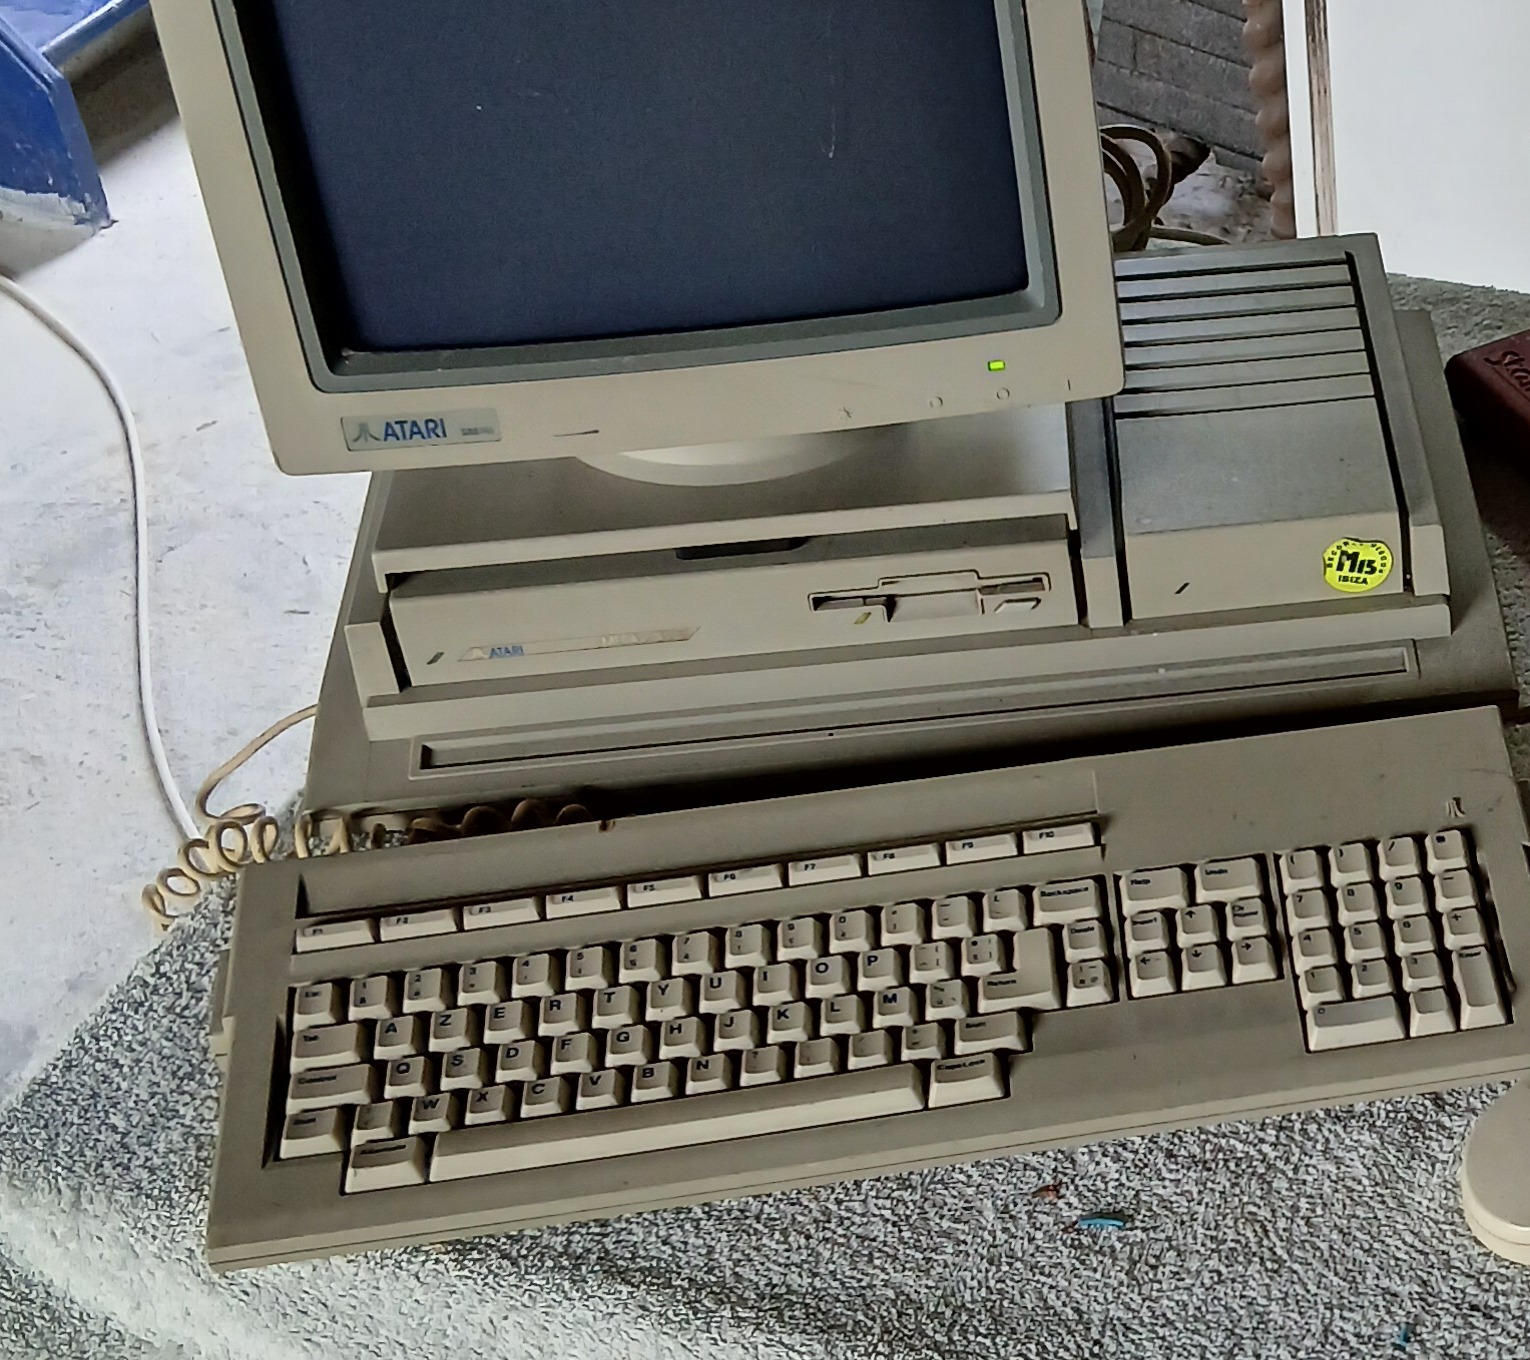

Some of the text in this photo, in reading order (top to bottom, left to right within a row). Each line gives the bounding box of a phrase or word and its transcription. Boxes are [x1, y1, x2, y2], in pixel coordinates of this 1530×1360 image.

[383, 417, 448, 442] ATARI
[488, 645, 525, 659] ATARI
[384, 1022, 398, 1034] A
[439, 1014, 453, 1027] Z
[493, 1006, 506, 1019] E
[549, 999, 562, 1012] R
[603, 991, 616, 1004] T
[657, 984, 670, 997] Y
[709, 977, 722, 989] U
[815, 962, 829, 975] O
[866, 955, 879, 967] P
[396, 1062, 411, 1075] Q
[451, 1054, 464, 1067] S
[505, 1047, 520, 1059] D
[560, 1038, 572, 1051] F
[616, 1031, 631, 1043] G
[669, 1023, 683, 1035] H
[724, 1016, 735, 1028] J
[777, 1008, 790, 1021] K
[830, 1002, 841, 1013] L
[882, 993, 898, 1004] M
[422, 1098, 440, 1110] W
[476, 1091, 489, 1103] X
[531, 1083, 546, 1095] C
[589, 1075, 602, 1086] V
[642, 1067, 655, 1079] B
[696, 1059, 710, 1070] N
